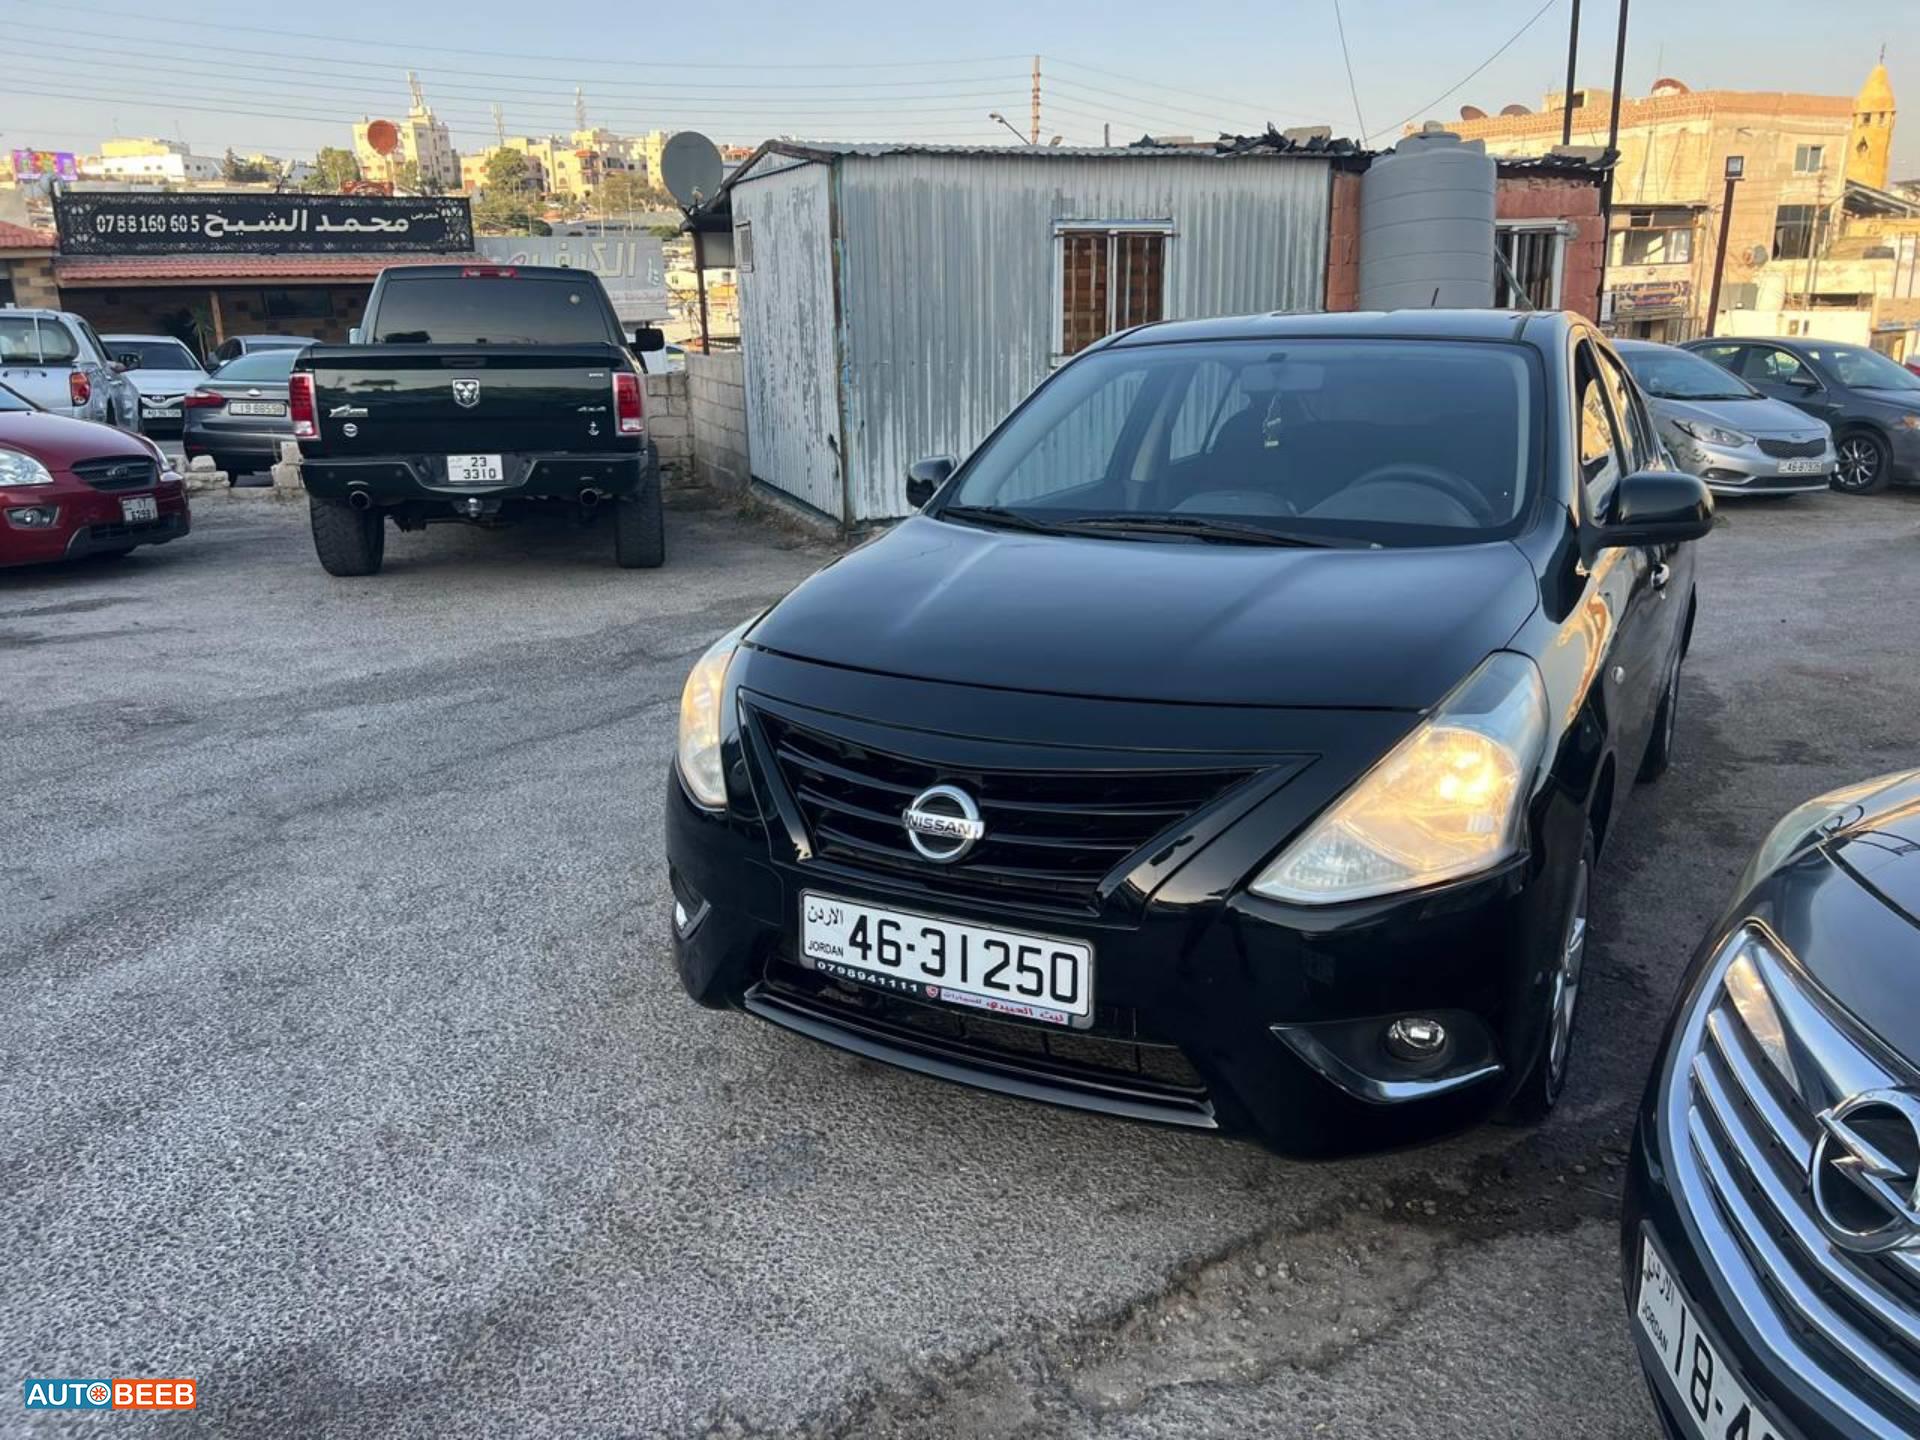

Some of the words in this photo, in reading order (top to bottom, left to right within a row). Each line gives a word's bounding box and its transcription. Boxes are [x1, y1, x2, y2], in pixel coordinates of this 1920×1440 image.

[204, 209, 308, 238] الشيخ
[315, 213, 409, 233] محمد
[470, 456, 487, 468] 23
[463, 468, 496, 480] 3310
[908, 814, 972, 837] NISSAN
[807, 905, 844, 927] الاردن
[808, 939, 844, 958] JORDAN
[848, 914, 1078, 1005] 46-31250
[816, 961, 918, 993] 0798941111
[1642, 1301, 1669, 1353] JORDAN
